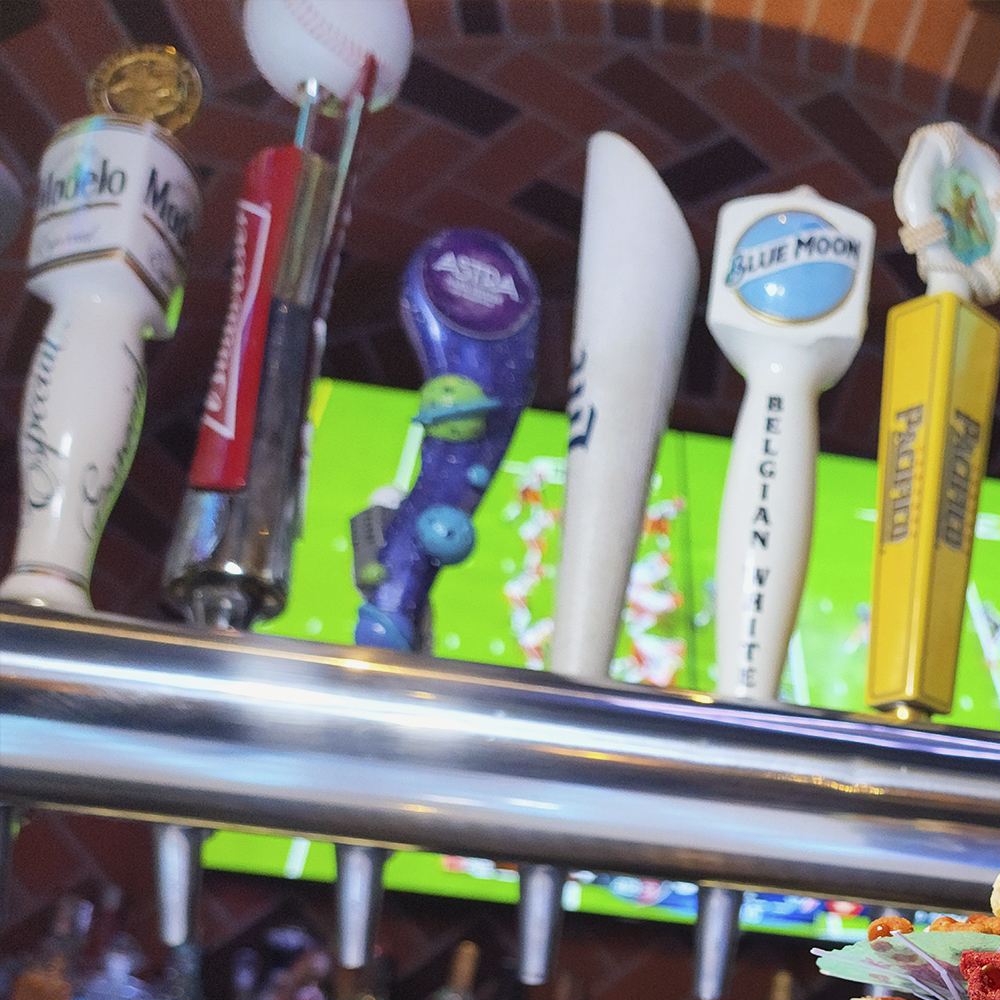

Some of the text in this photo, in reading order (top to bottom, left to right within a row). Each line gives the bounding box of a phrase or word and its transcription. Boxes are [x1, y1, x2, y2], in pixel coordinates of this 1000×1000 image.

[725, 235, 861, 288] BLUE MOON
[751, 395, 784, 550] BELGIAN
